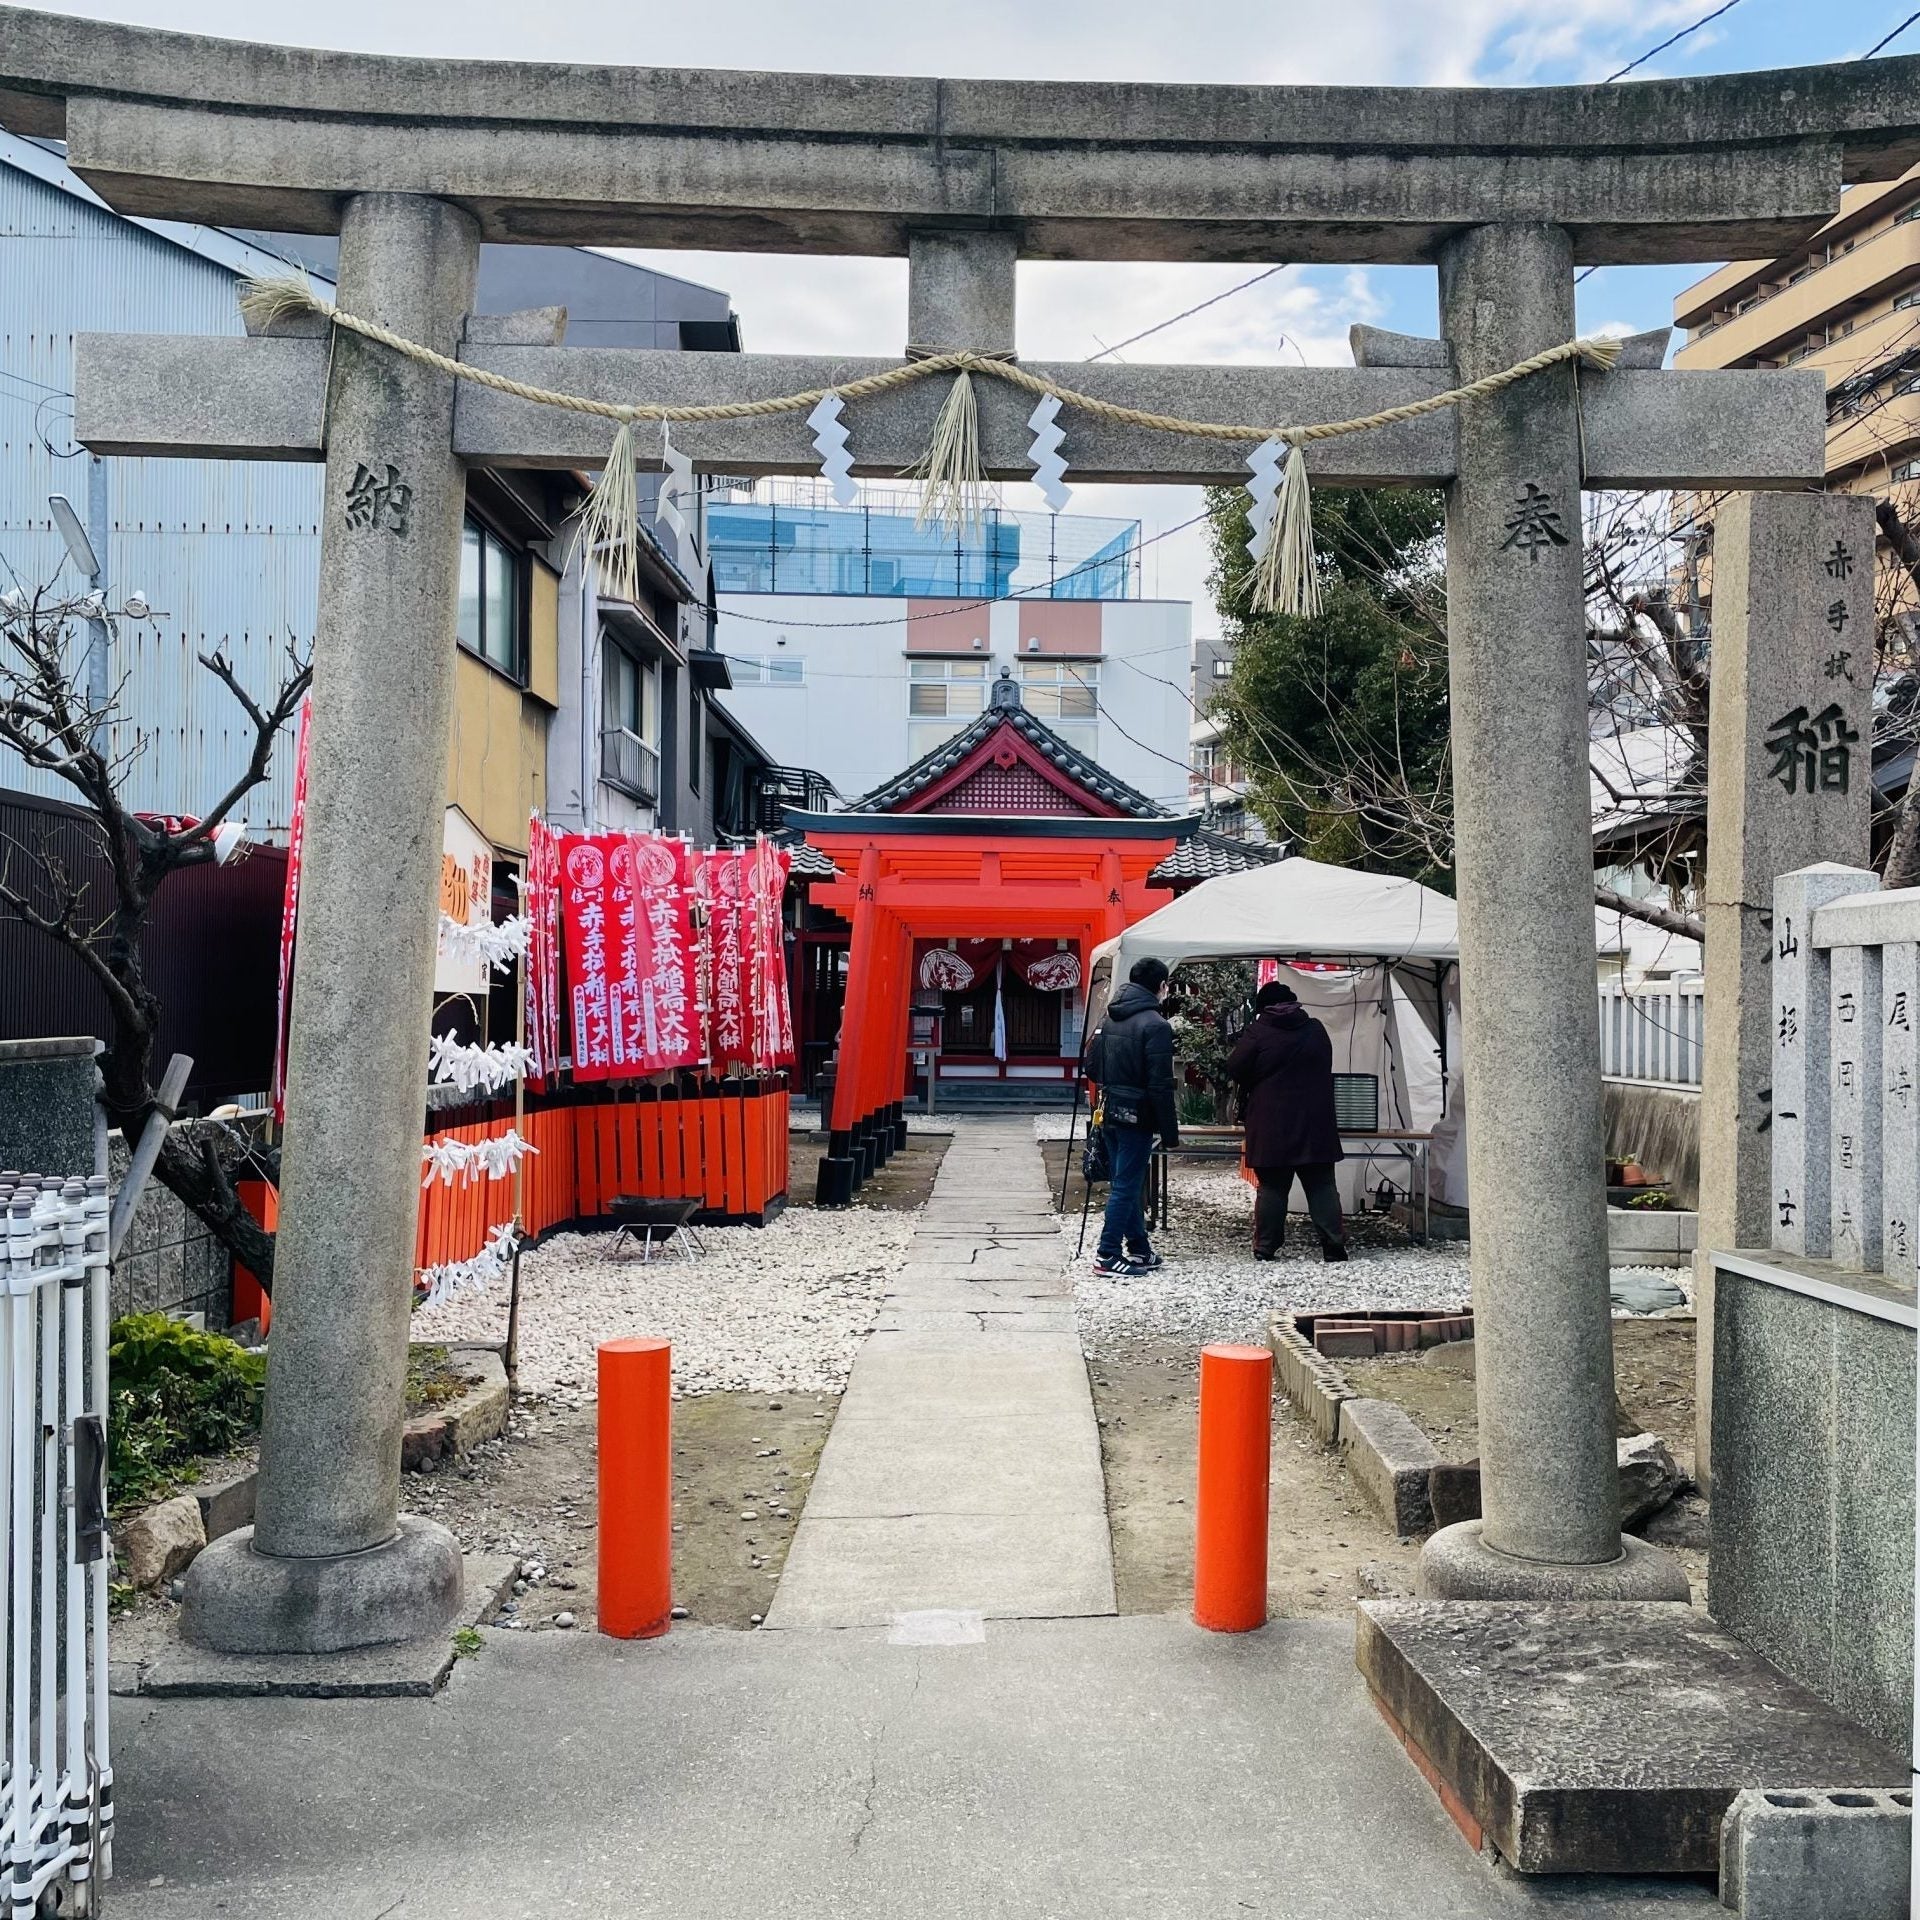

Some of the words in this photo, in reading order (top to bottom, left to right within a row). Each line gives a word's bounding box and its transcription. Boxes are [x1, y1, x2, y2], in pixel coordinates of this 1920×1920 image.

[344, 462, 413, 538] 納
[1500, 483, 1570, 561] 奉
[858, 883, 874, 902] 納
[1107, 887, 1122, 907] 奉
